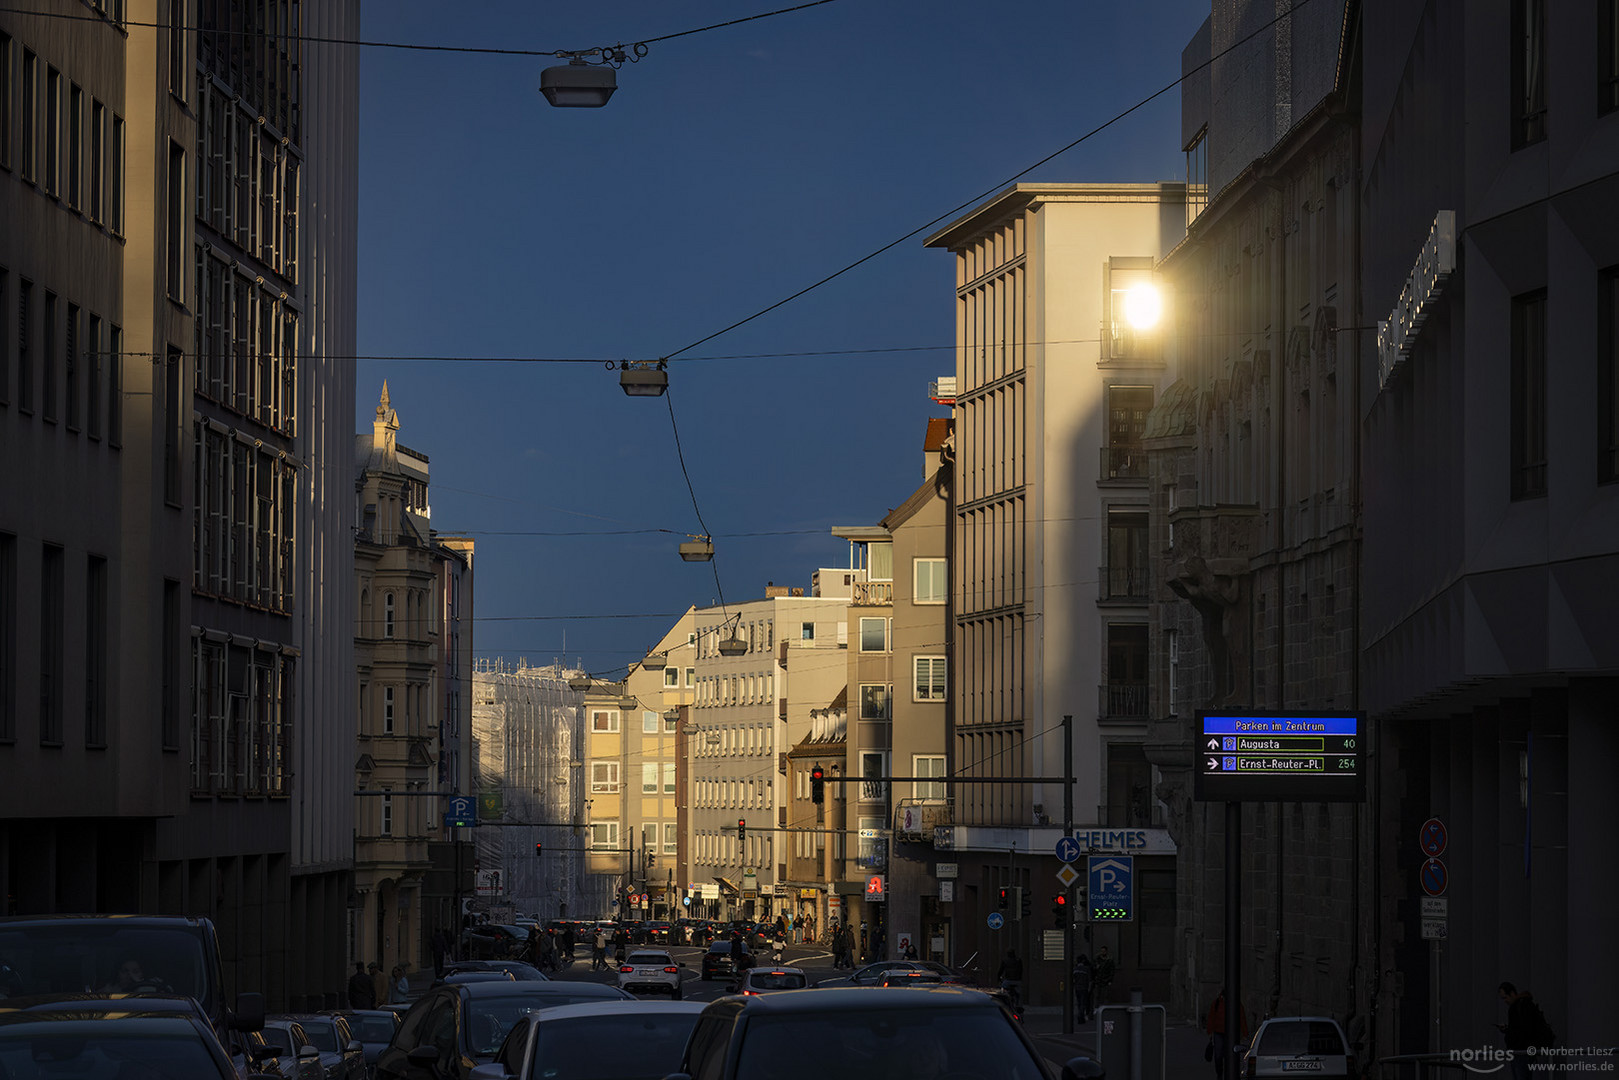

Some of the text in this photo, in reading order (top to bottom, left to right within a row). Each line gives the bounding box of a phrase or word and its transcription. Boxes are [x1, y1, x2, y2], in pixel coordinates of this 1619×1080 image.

[1235, 720, 1325, 731] Parken im Zentrum
[1240, 739, 1280, 750] Augusta
[1343, 739, 1356, 749] 40
[1240, 759, 1323, 770] Ernst-Reuter-Pl.
[1338, 759, 1356, 769] 254
[456, 804, 466, 815] P
[1076, 831, 1146, 848] HELMES
[1100, 869, 1116, 892] P
